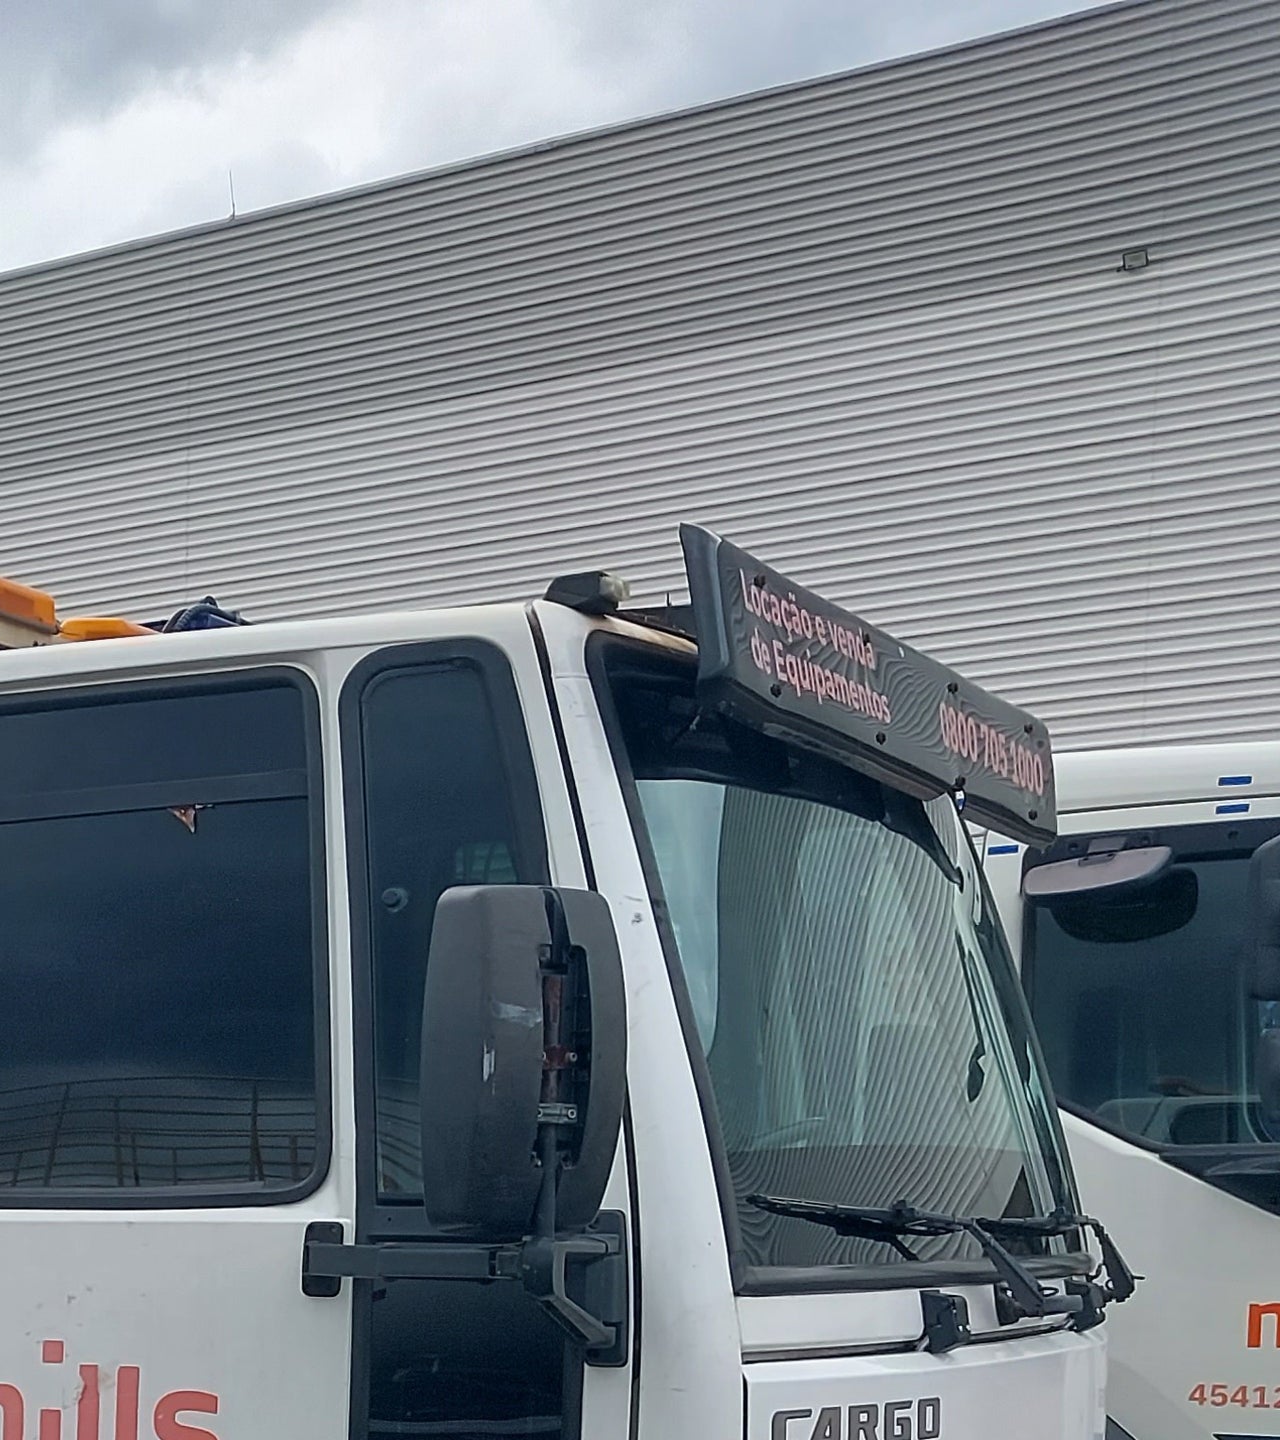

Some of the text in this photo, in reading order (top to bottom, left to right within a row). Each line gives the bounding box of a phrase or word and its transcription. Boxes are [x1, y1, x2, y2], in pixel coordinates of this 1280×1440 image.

[750, 626, 891, 724] de Equipamentos
[814, 614, 828, 647] e
[827, 619, 876, 671] venda
[940, 702, 1044, 797] 0800 705 1000
